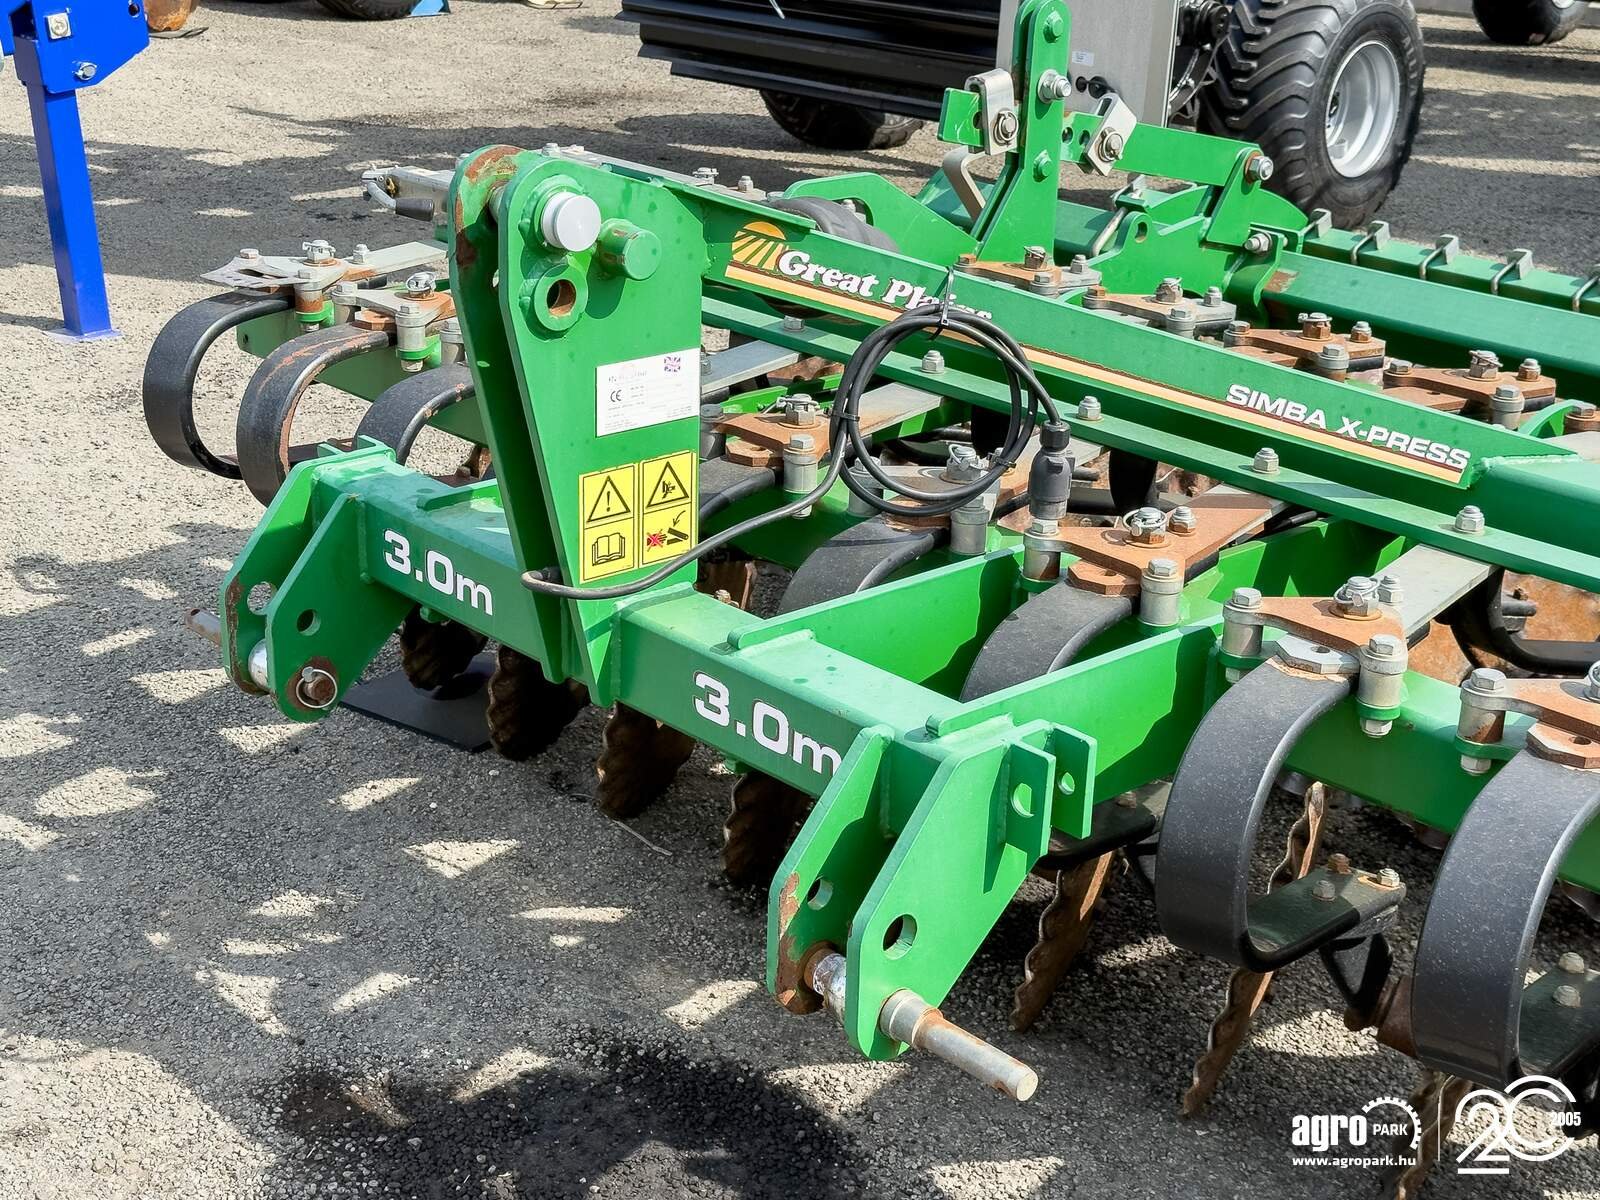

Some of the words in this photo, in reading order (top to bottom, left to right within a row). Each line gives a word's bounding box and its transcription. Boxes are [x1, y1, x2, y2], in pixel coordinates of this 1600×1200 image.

[777, 250, 880, 298] Great
[1225, 383, 1327, 430] SIMBA
[1336, 416, 1472, 470] X-PRESS
[383, 529, 493, 616] 3.0m
[694, 672, 842, 778] 3.0m
